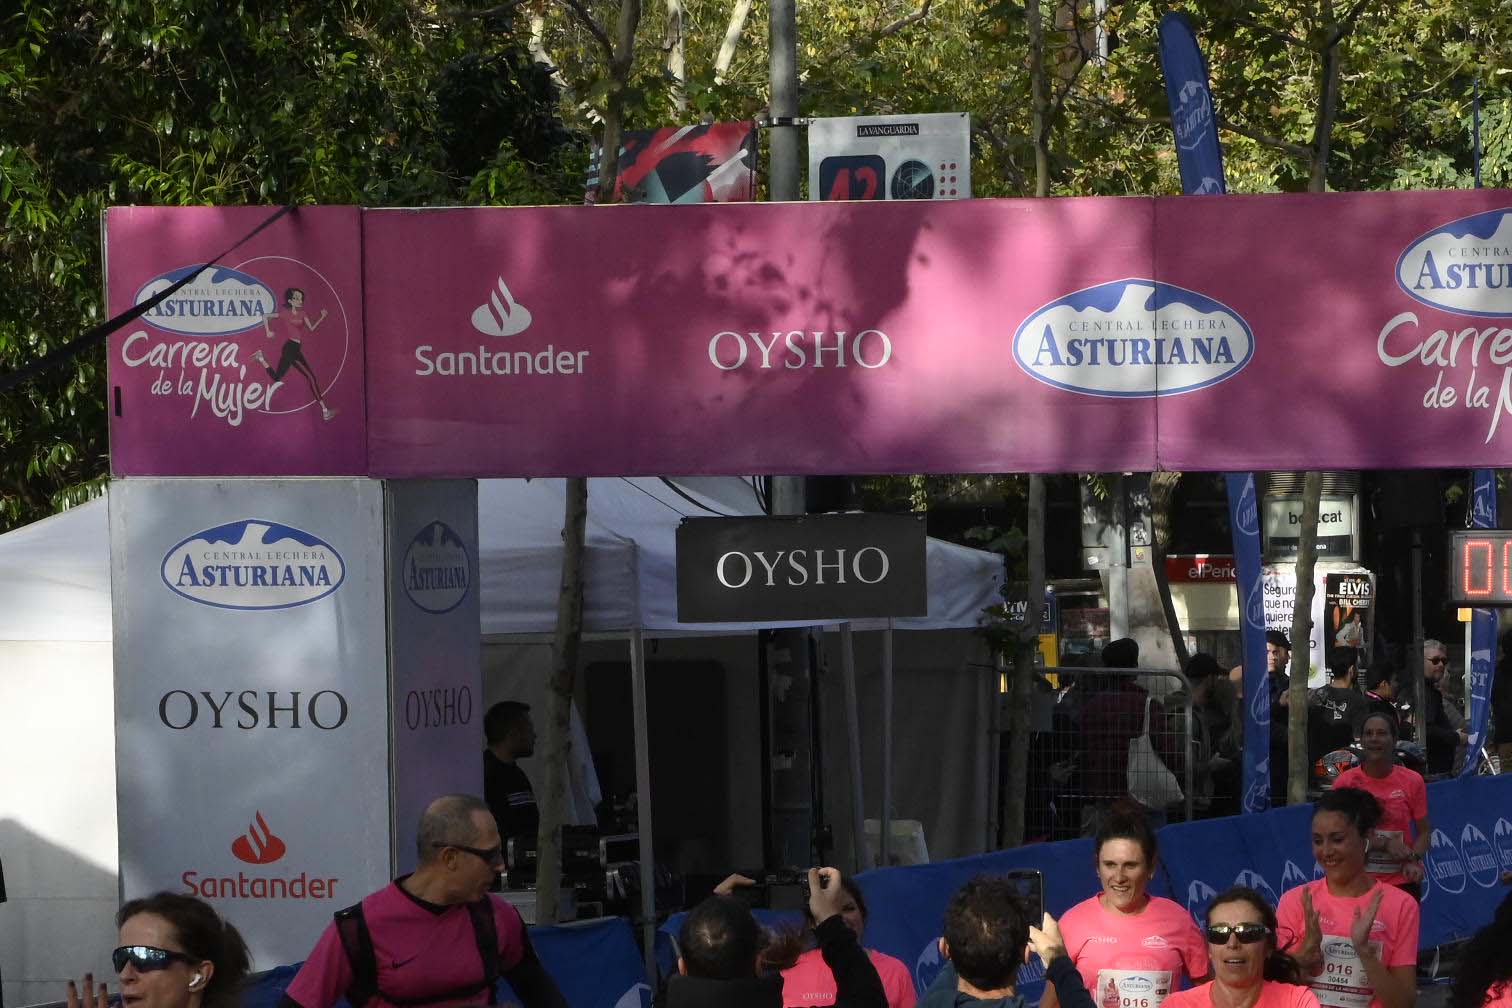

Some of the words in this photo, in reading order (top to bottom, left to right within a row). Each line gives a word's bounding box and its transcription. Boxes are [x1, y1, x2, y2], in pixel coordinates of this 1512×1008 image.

[144, 291, 266, 318] ASTURIANA
[173, 287, 211, 297] ENTRAL
[1068, 319, 1144, 332] CENTRAL
[1150, 319, 1227, 331] LECHERA
[121, 331, 240, 369] Carrera
[415, 344, 589, 376] Santander
[708, 329, 892, 371] OYSHO
[1031, 323, 1236, 367] ASTURIANA
[151, 370, 174, 397] de
[177, 370, 194, 397] la
[190, 364, 283, 427] Mujer
[1423, 370, 1458, 410] de
[1465, 367, 1491, 410] la
[175, 552, 332, 588] ASTURIANA
[203, 550, 264, 561] CENTRAL
[267, 550, 326, 561] LECHERA
[716, 546, 890, 589] OYSHO
[408, 556, 468, 591] ASTURIANA
[1340, 582, 1370, 595] ELVIS
[158, 689, 349, 731] OYSHO
[406, 685, 473, 731] OYSHO
[181, 871, 339, 899] Santander
[1326, 963, 1353, 976] 016
[1122, 998, 1149, 1008] 016
